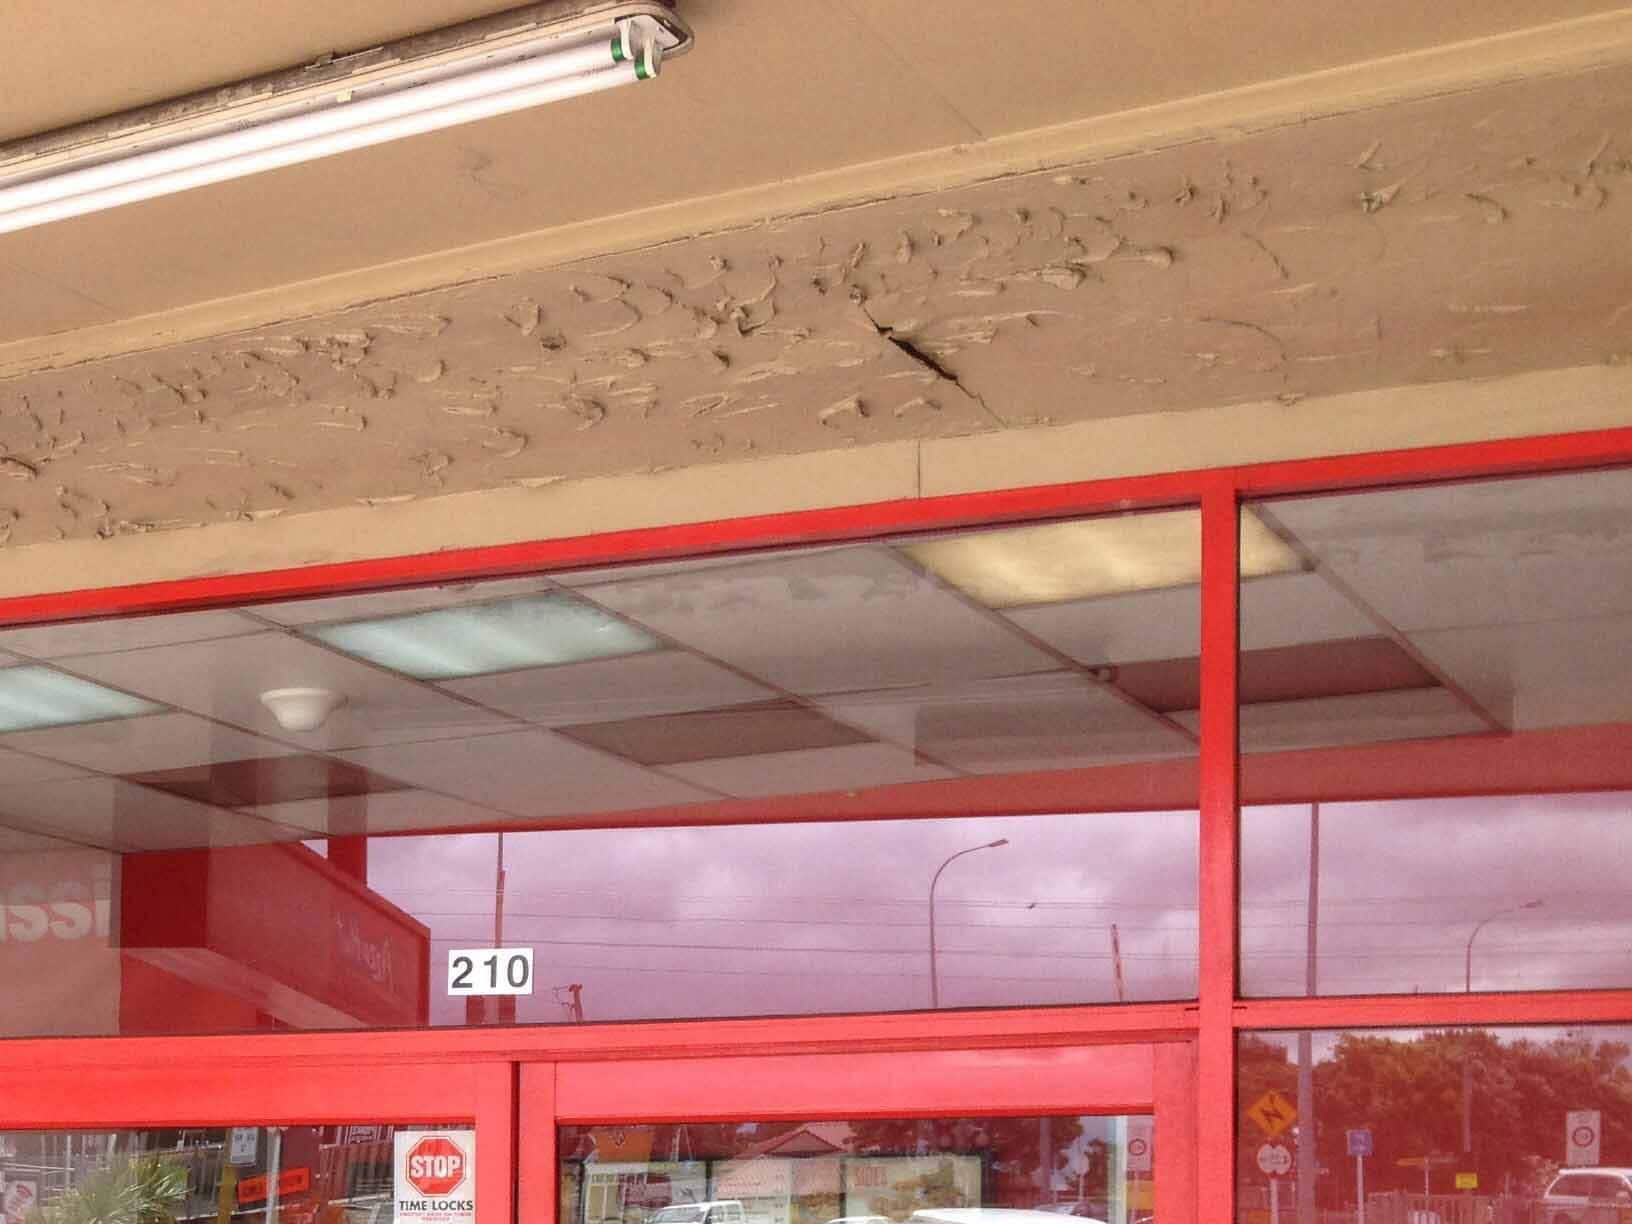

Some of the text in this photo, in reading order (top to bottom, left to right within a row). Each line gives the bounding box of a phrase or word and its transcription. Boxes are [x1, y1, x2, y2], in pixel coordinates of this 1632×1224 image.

[452, 955, 530, 988] 210
[411, 1155, 461, 1178] STOP
[400, 1200, 473, 1211] TIME LOCKS
